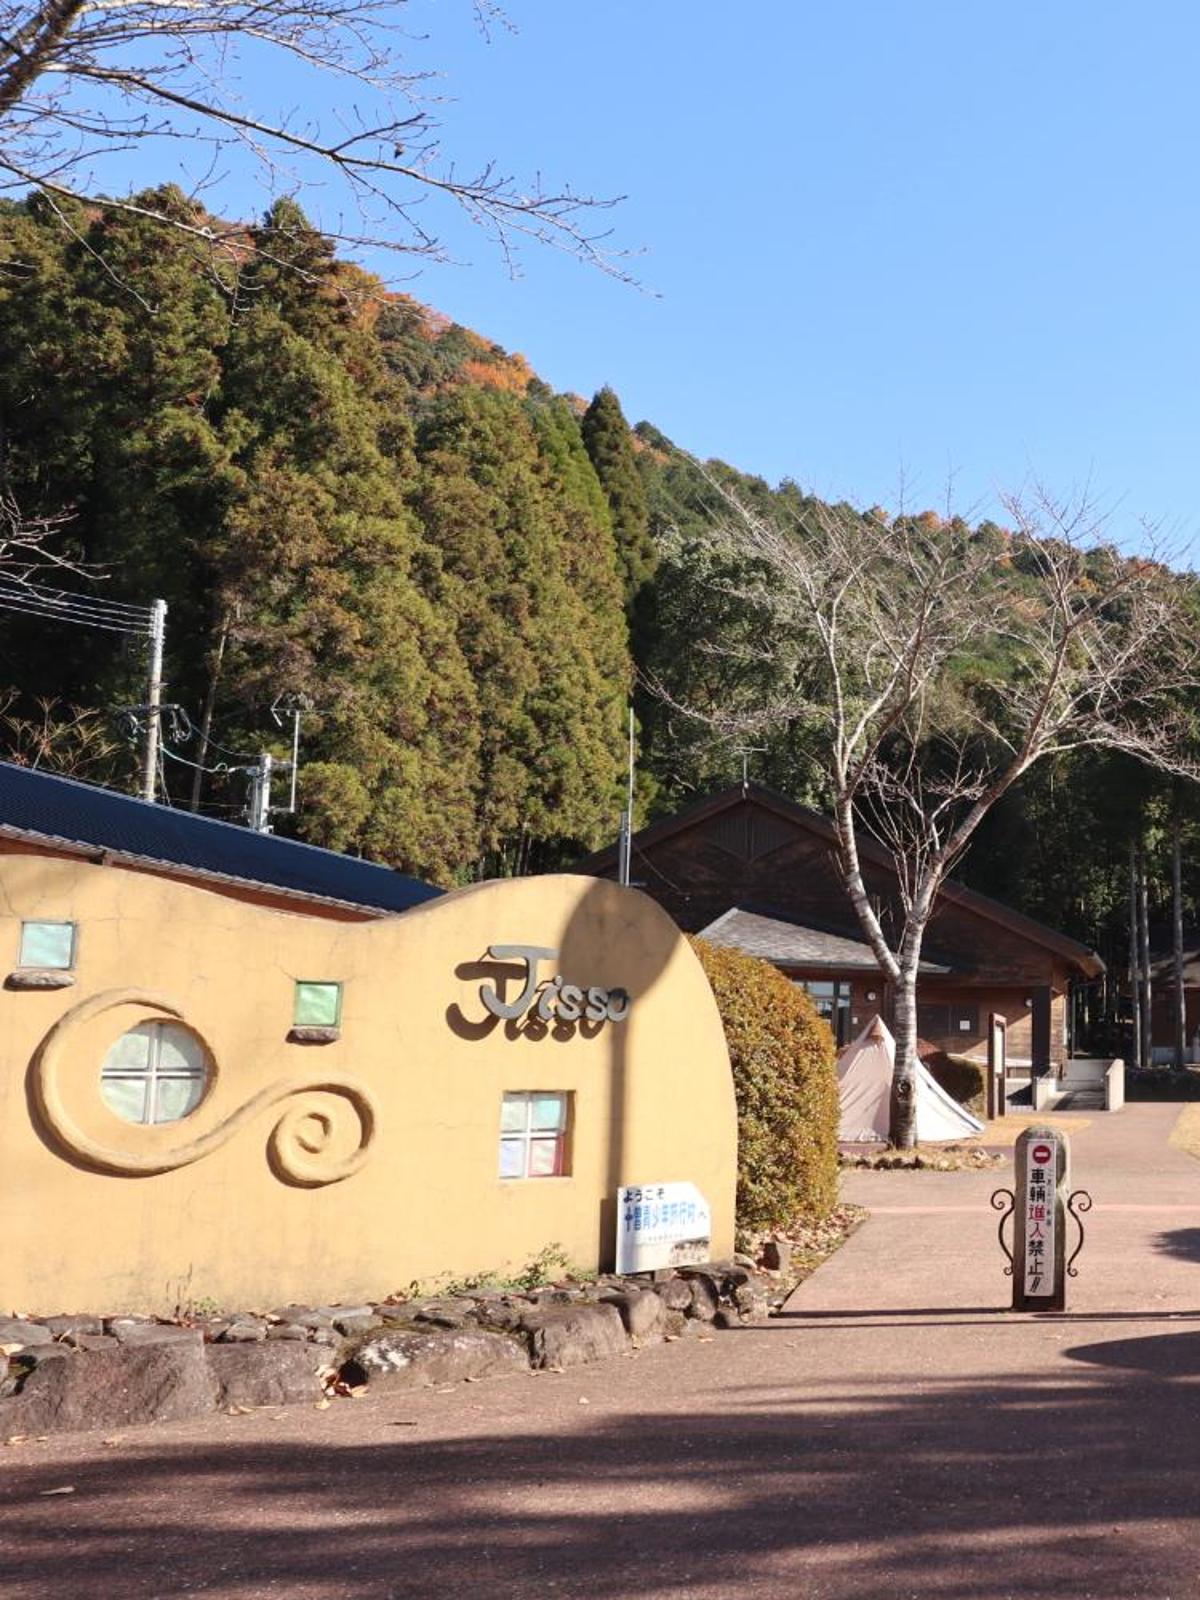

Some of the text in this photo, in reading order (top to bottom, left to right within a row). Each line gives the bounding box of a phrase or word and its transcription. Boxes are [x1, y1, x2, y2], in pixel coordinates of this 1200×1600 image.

[479, 945, 630, 1023] Jisso
[624, 1187, 665, 1203] ようこそ
